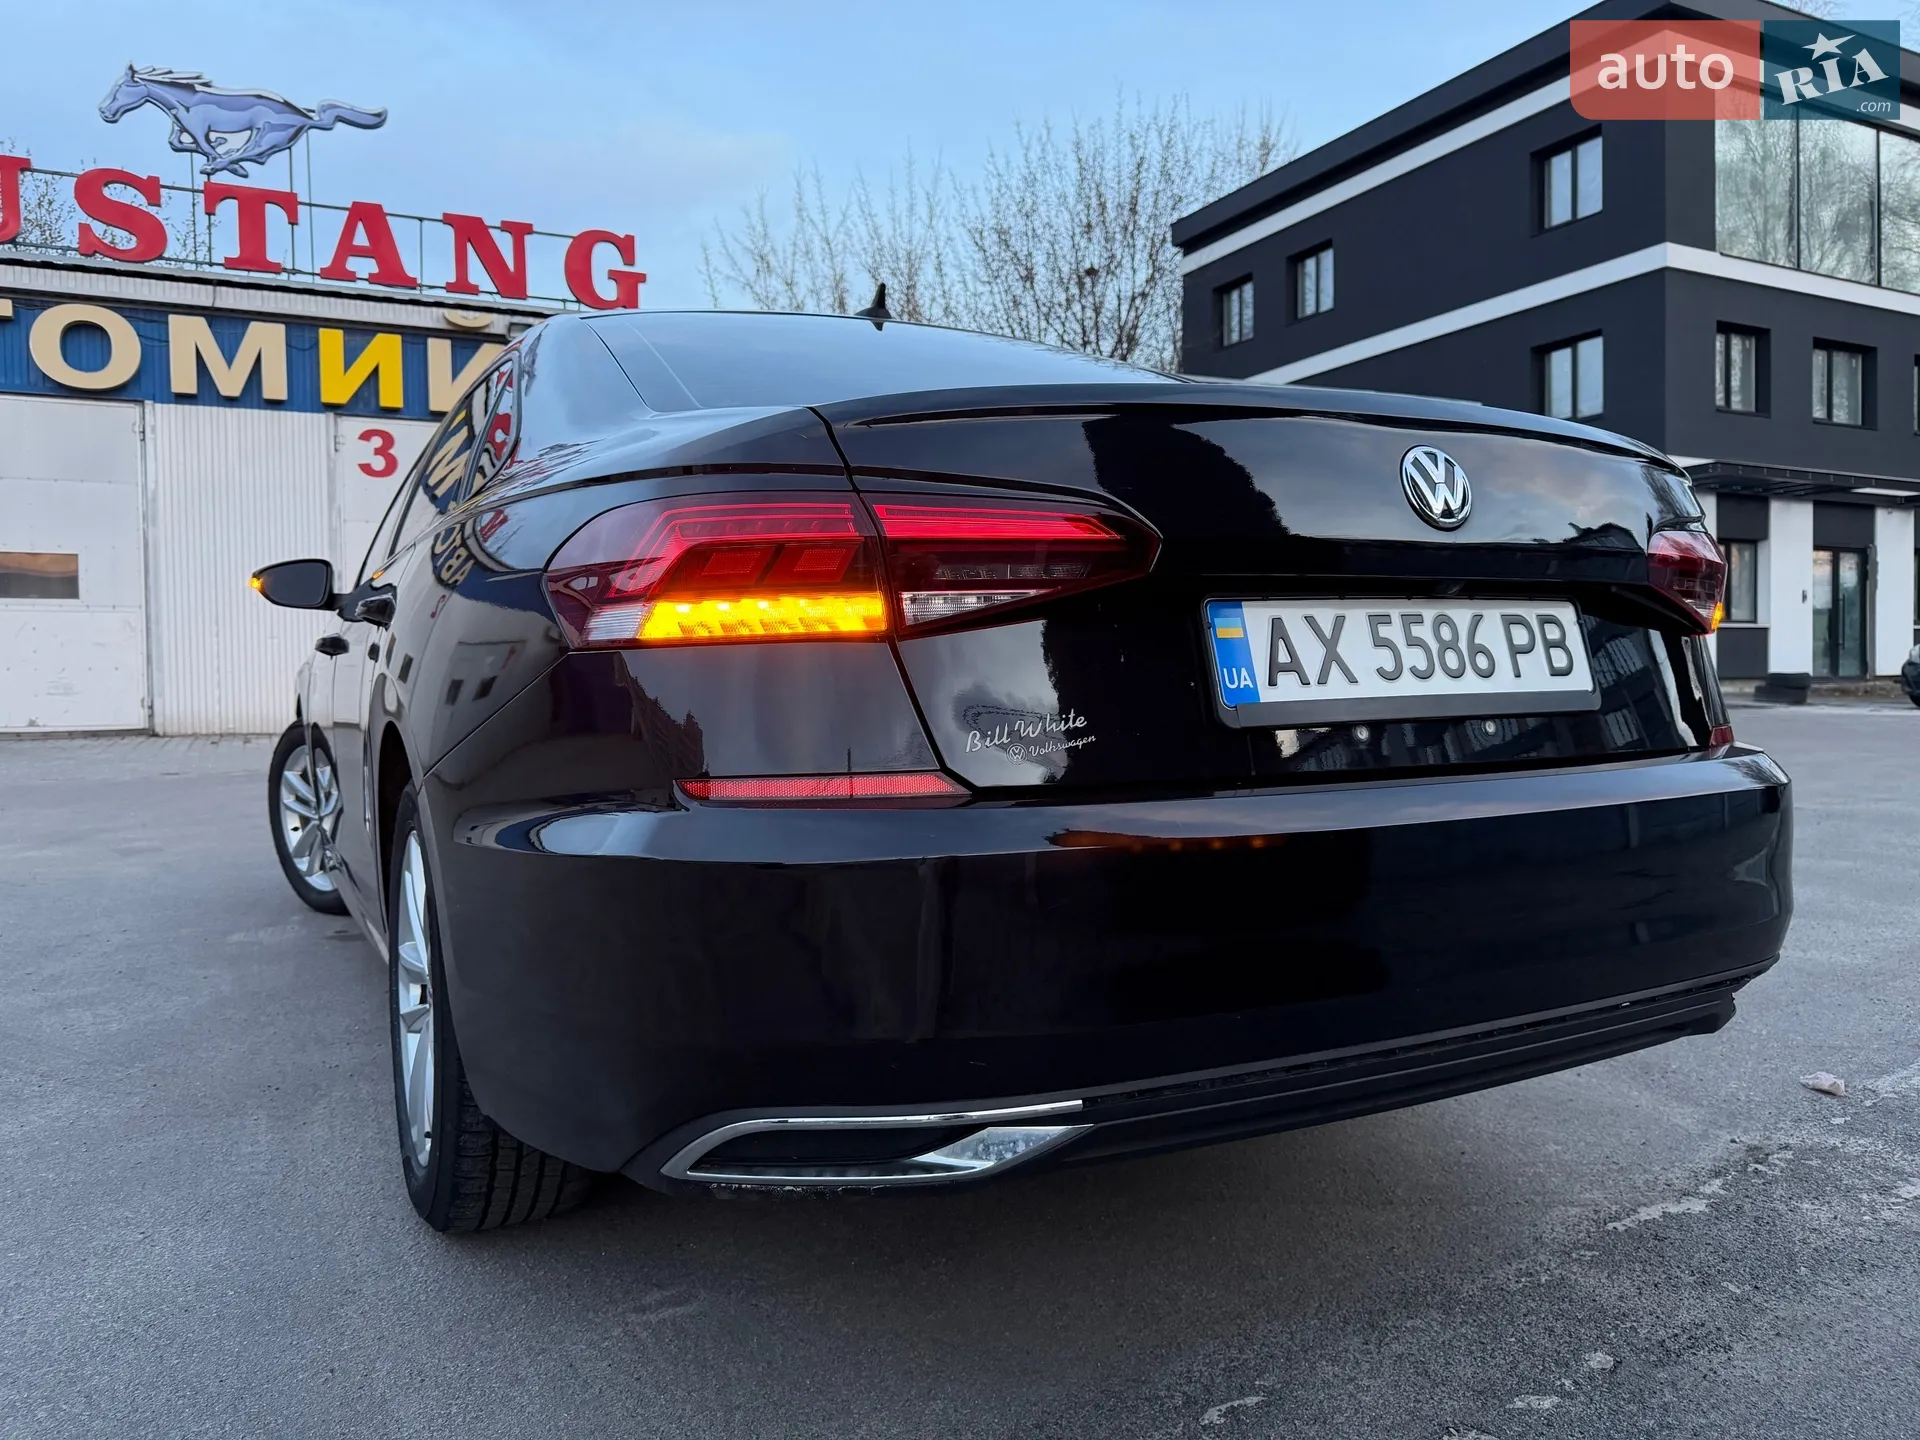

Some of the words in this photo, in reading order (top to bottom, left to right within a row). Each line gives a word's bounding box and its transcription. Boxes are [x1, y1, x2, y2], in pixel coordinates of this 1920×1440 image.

[0, 298, 505, 413] ОМИЙ
[357, 428, 399, 479] 3
[1267, 615, 1359, 687] AX
[1367, 613, 1496, 681] 5586
[1500, 613, 1575, 678] PB
[1223, 667, 1254, 690] UA
[965, 722, 1011, 753] Bill
[1014, 708, 1088, 738] White
[1028, 734, 1097, 758] Volkswagen
